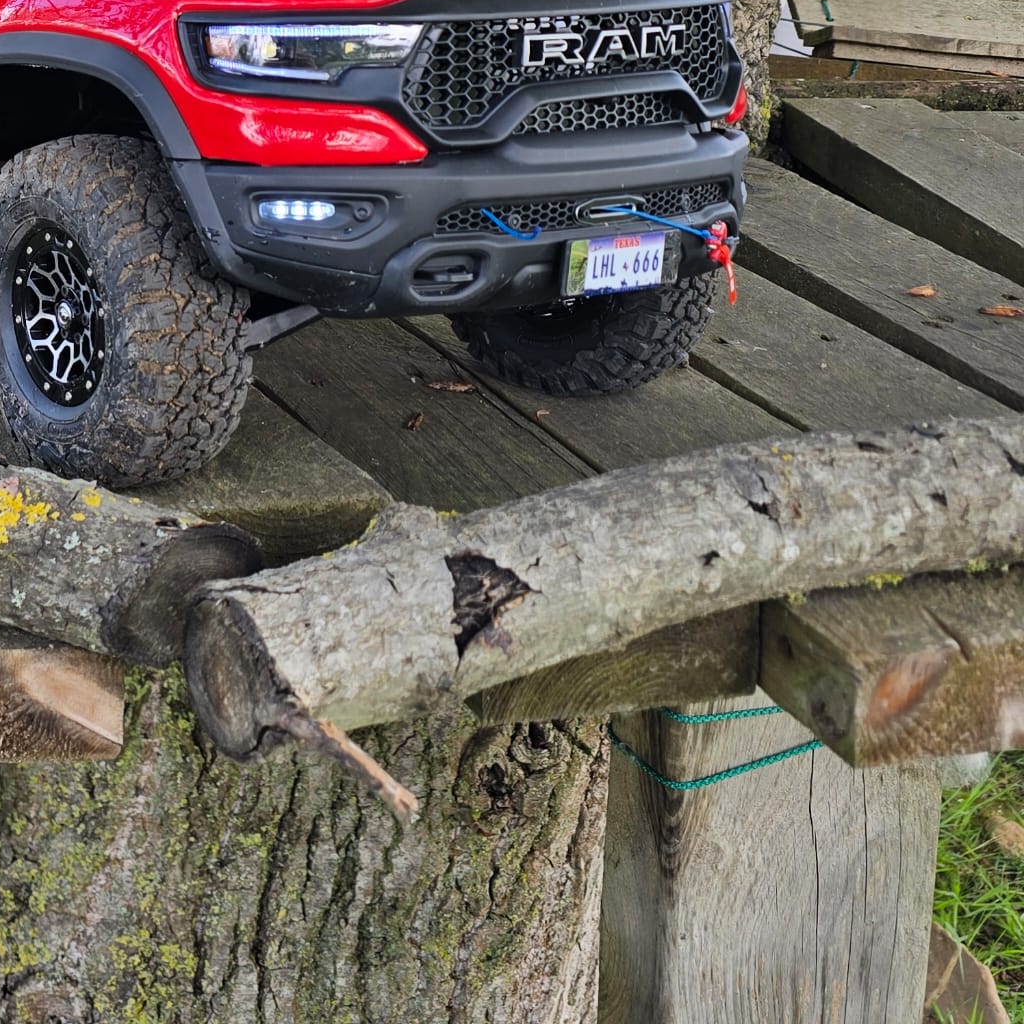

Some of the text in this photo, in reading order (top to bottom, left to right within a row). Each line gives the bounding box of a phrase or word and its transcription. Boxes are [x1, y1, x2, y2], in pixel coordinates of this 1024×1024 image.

[523, 25, 686, 67] RAM
[615, 237, 641, 249] TEXAS
[592, 249, 659, 280] LHL 666
